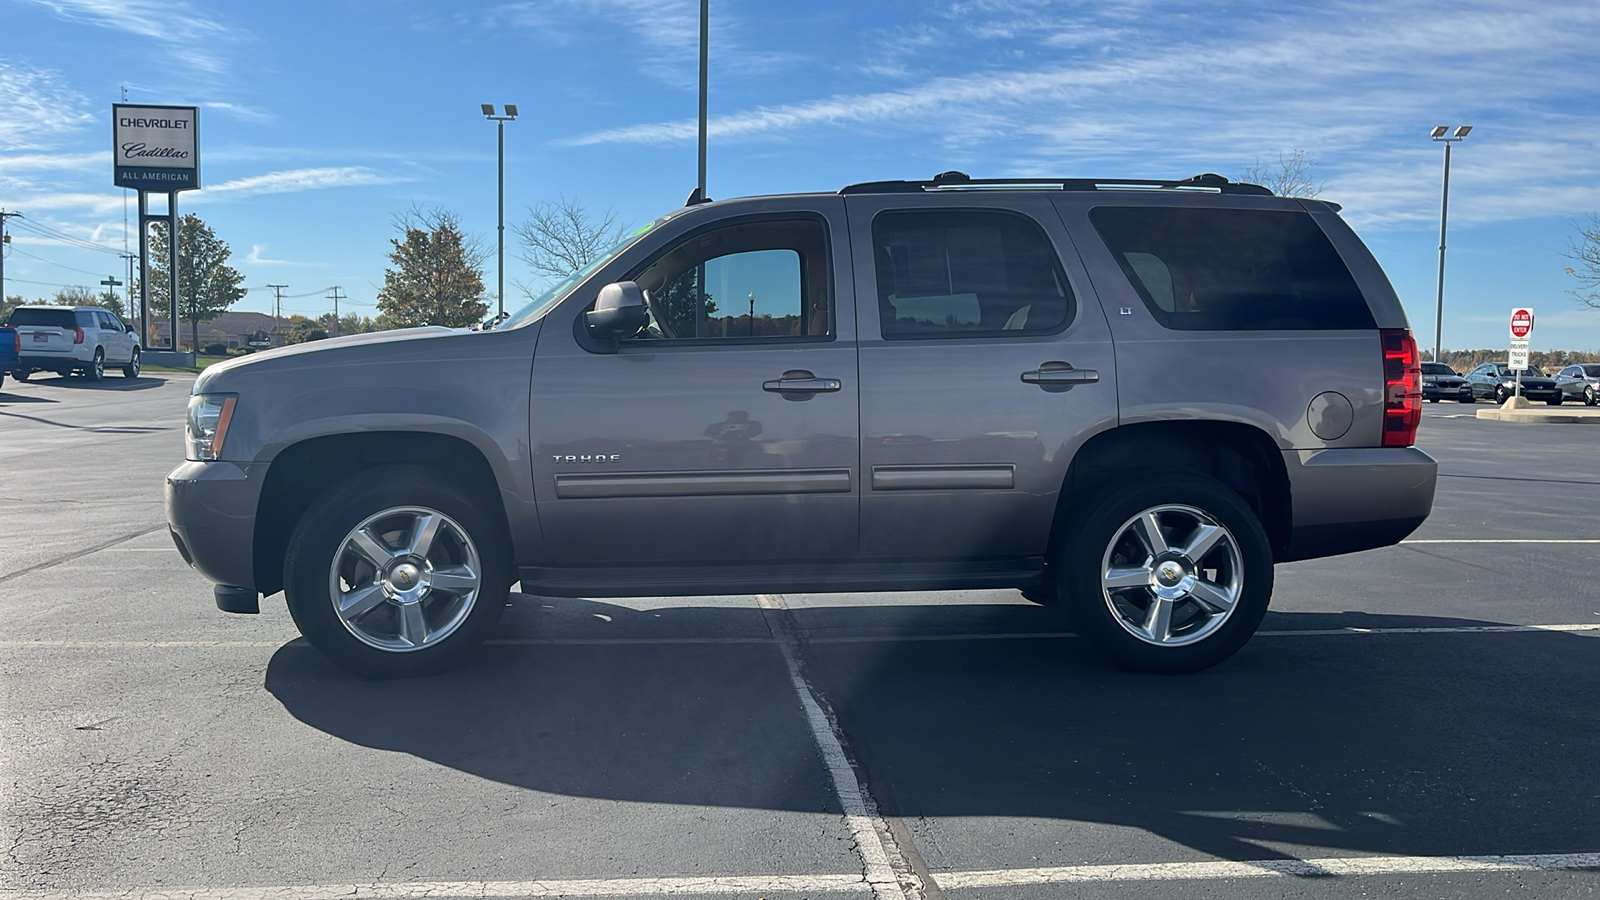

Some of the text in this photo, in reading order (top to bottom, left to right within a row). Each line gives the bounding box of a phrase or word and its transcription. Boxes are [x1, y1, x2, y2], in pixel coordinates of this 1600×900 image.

[120, 118, 189, 129] CHEVROLET
[121, 142, 189, 159] Cadillac
[122, 172, 189, 181] ALL AMERICAN
[1119, 307, 1133, 315] LT
[552, 454, 620, 464] TAHOE
